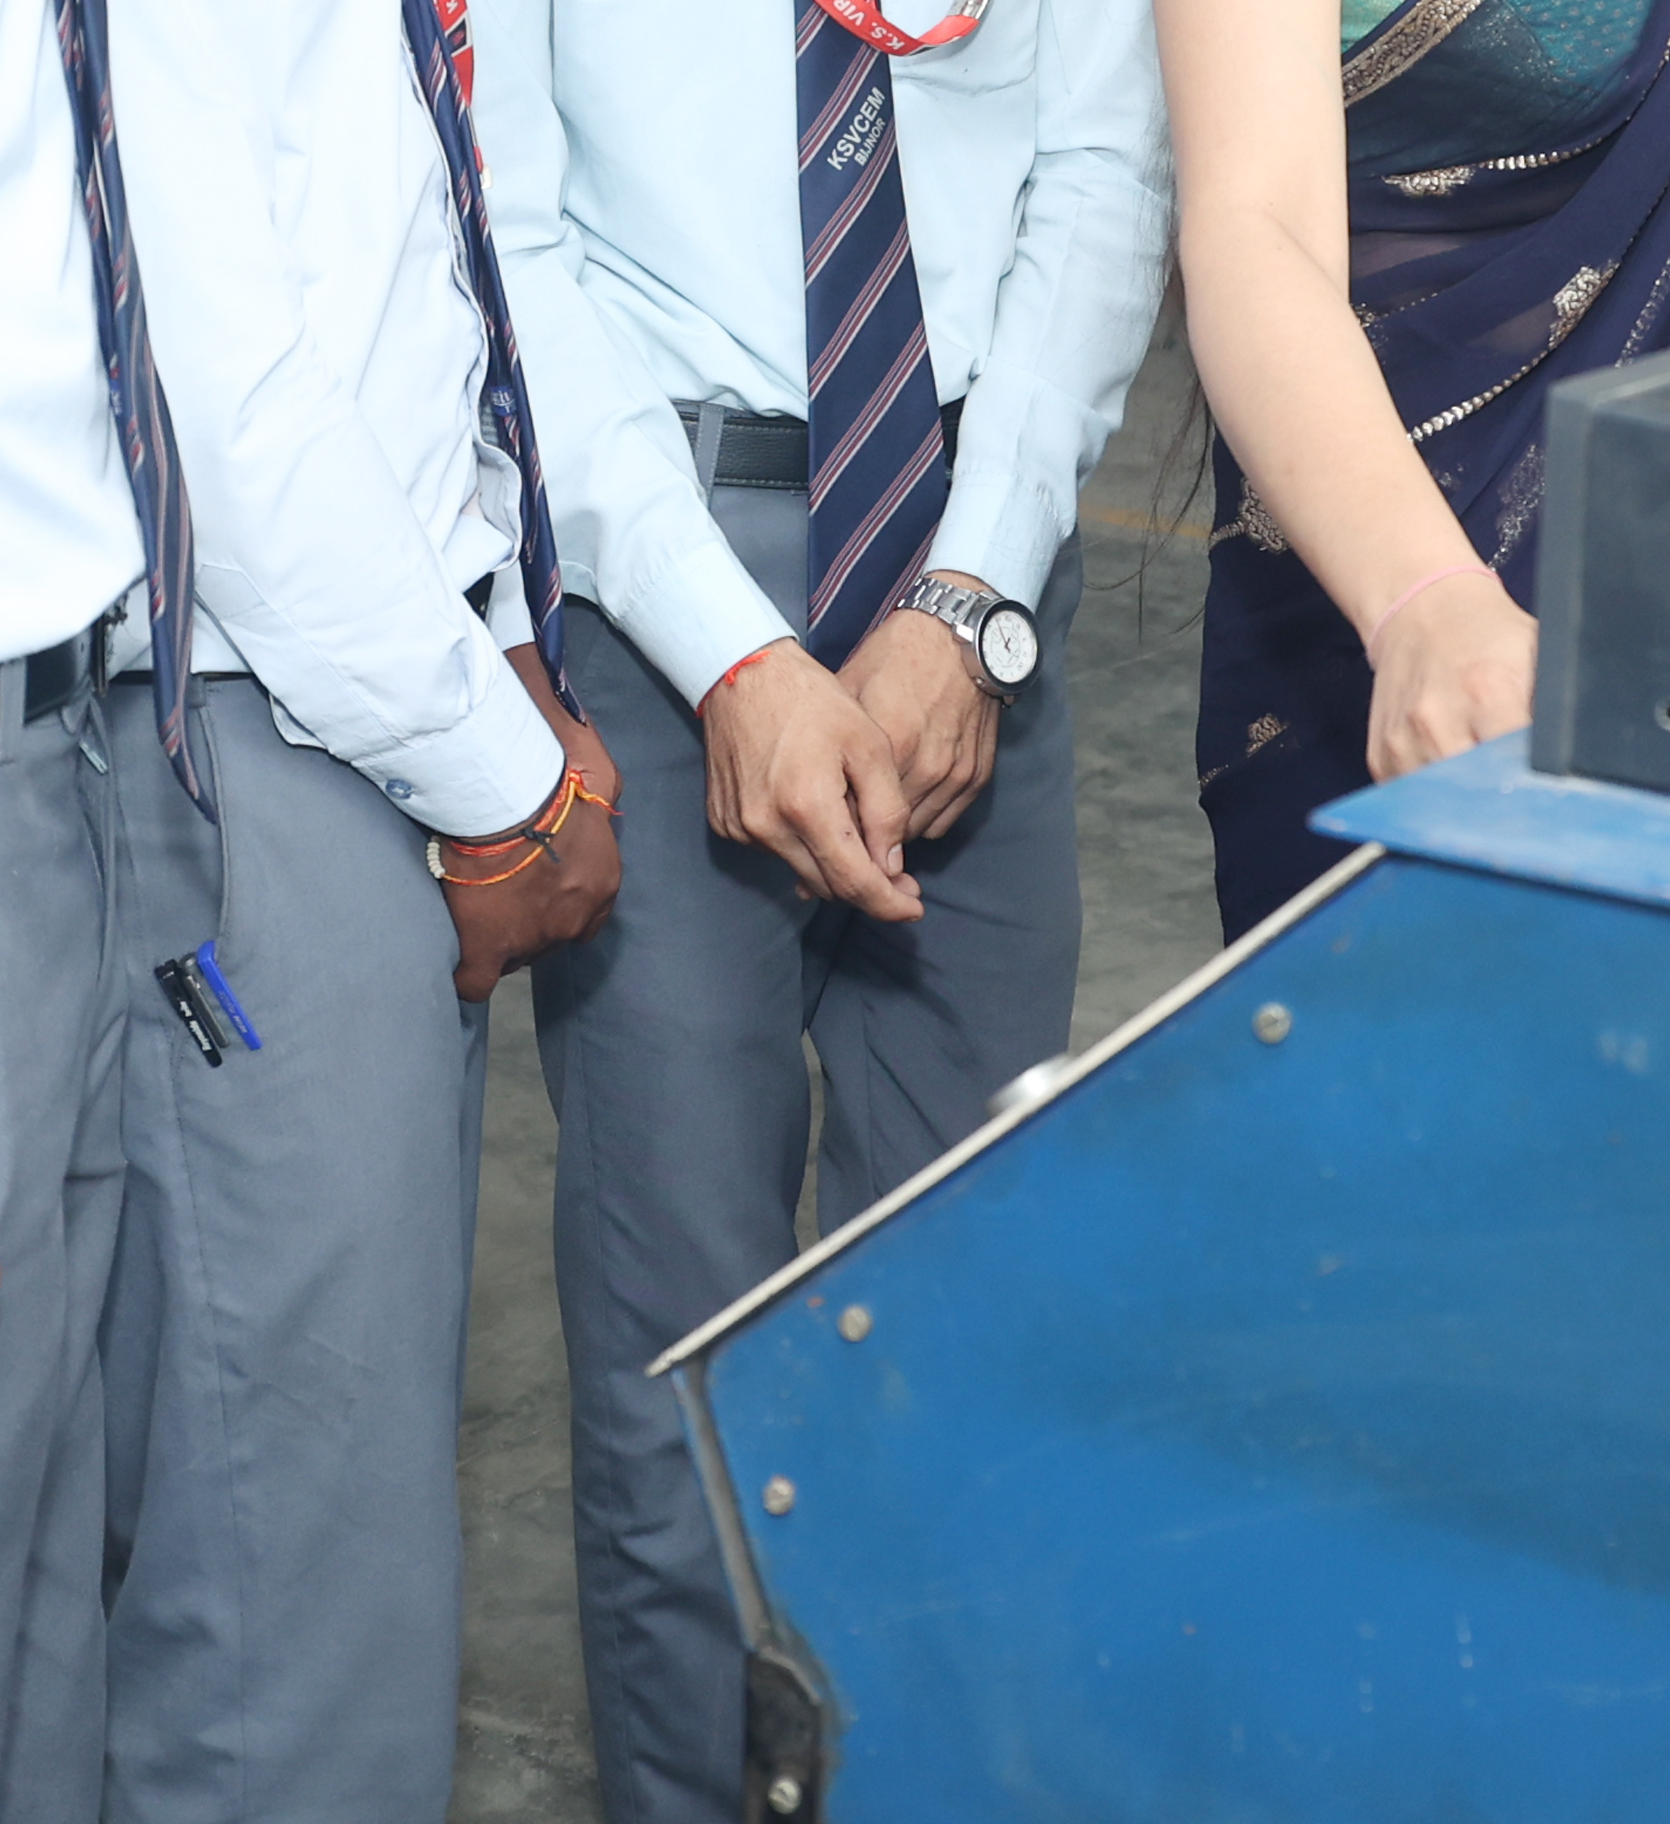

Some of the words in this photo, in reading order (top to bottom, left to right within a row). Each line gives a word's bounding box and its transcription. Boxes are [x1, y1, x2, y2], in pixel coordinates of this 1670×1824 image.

[871, 21, 906, 51] K.S.
[827, 86, 886, 171] KSVCEM
[854, 117, 886, 167] BIJNOR
